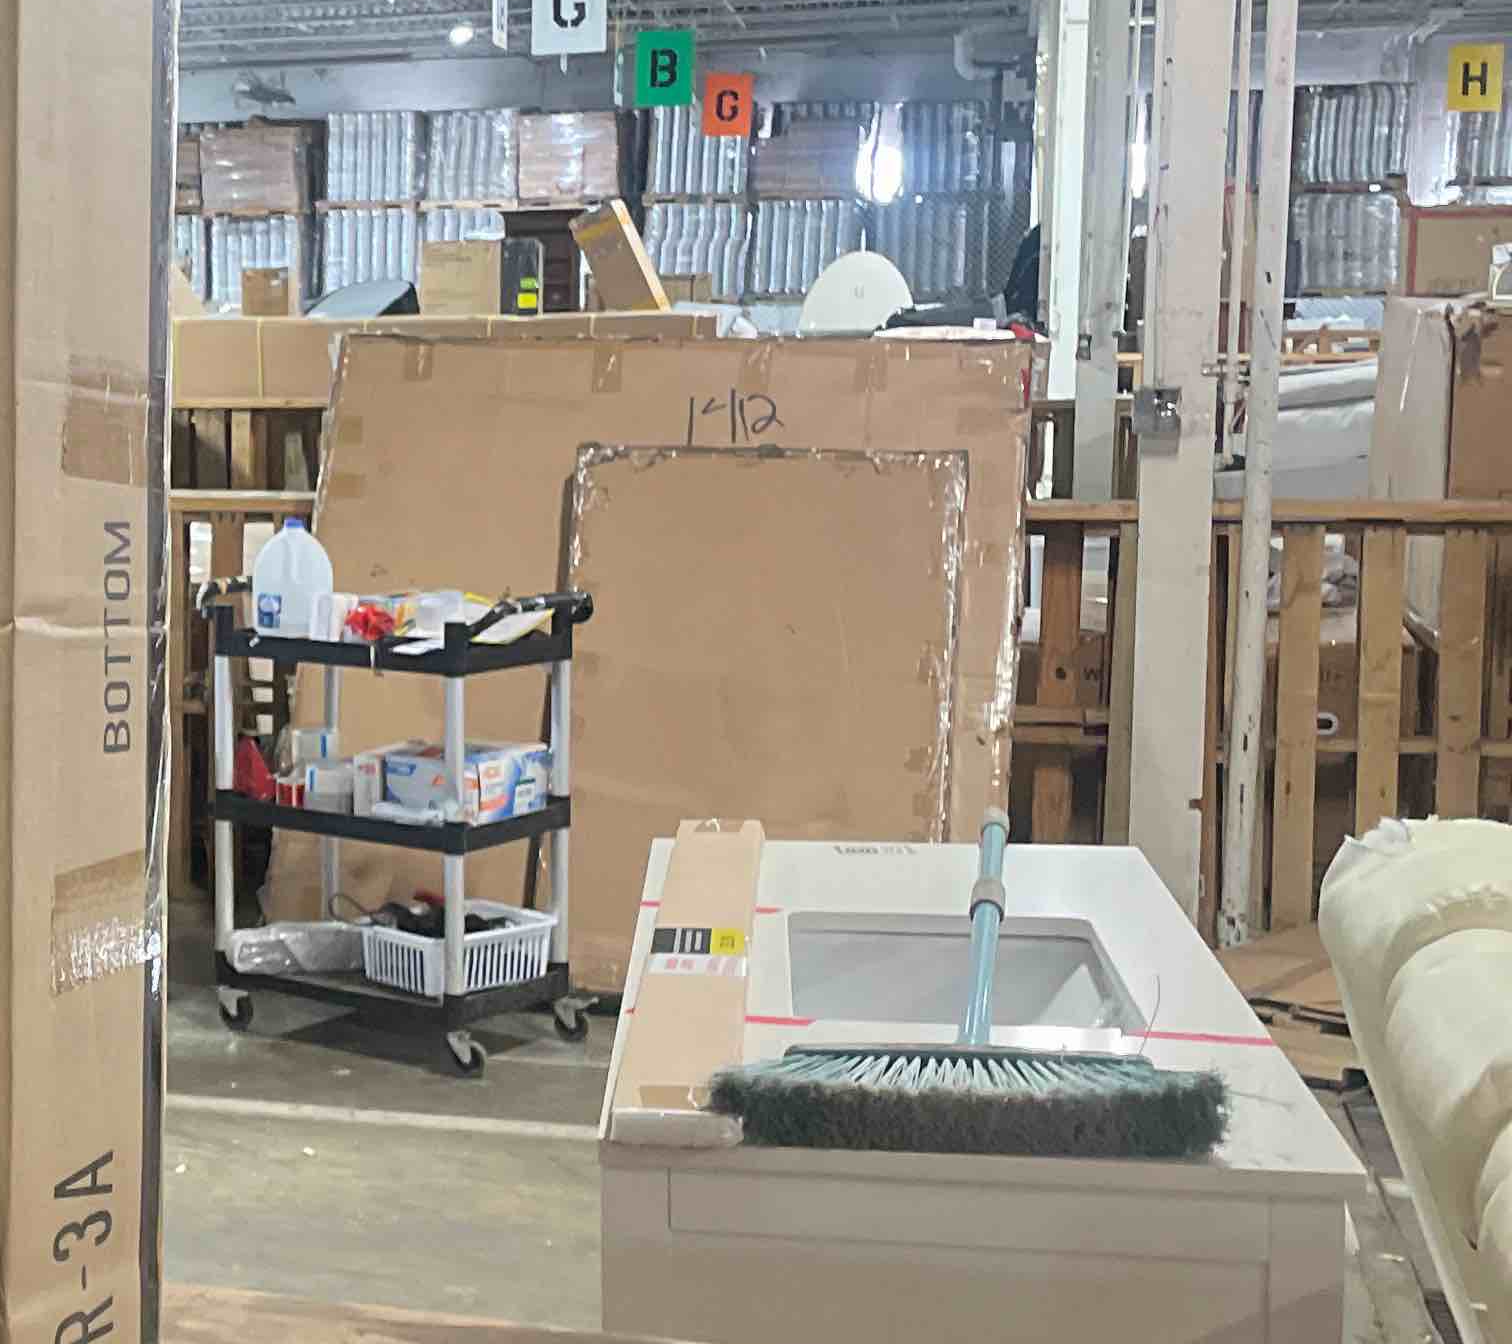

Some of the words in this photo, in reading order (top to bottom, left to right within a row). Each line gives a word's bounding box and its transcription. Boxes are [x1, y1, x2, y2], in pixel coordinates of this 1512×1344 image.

[650, 49, 679, 89] B
[1461, 61, 1488, 96] H
[714, 90, 740, 123] G
[104, 521, 131, 753] BOTTOM
